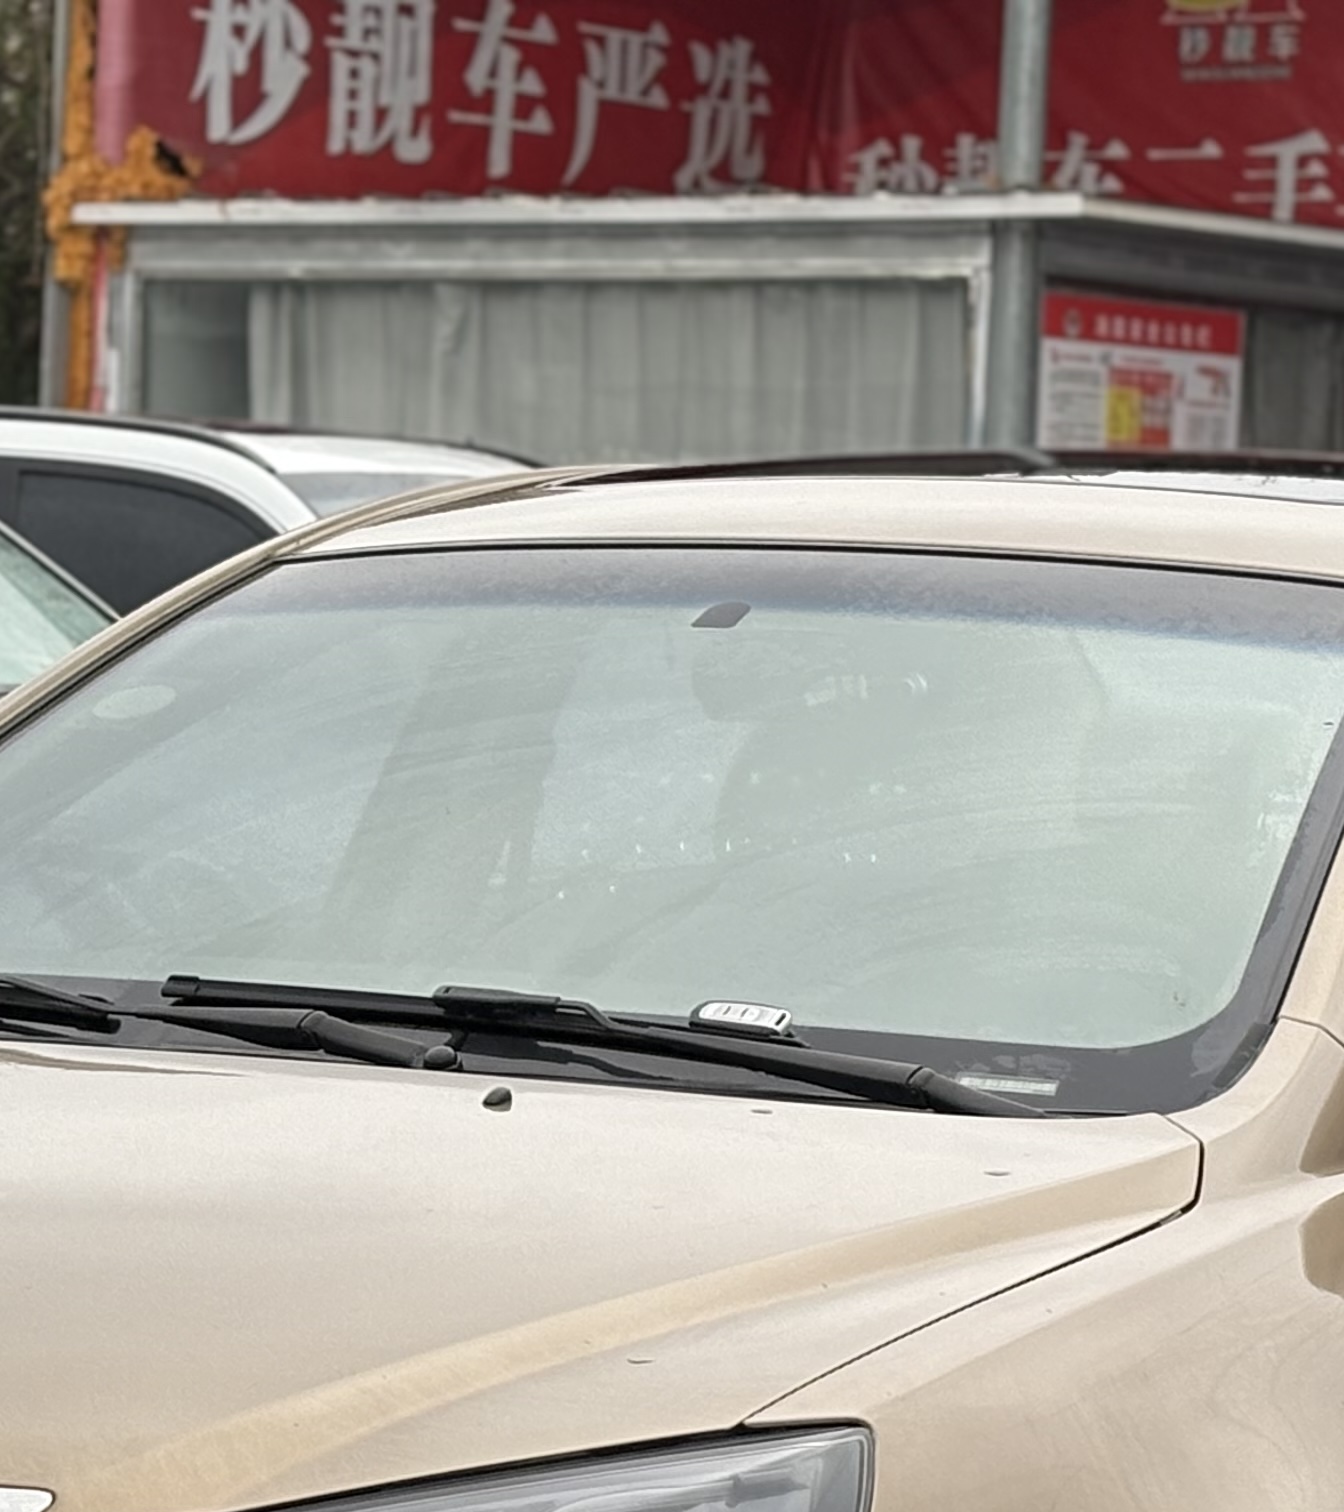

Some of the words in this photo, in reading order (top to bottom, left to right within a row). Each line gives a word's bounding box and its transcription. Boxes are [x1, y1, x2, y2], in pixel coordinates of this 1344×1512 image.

[191, 0, 772, 194] 秒靓车严选
